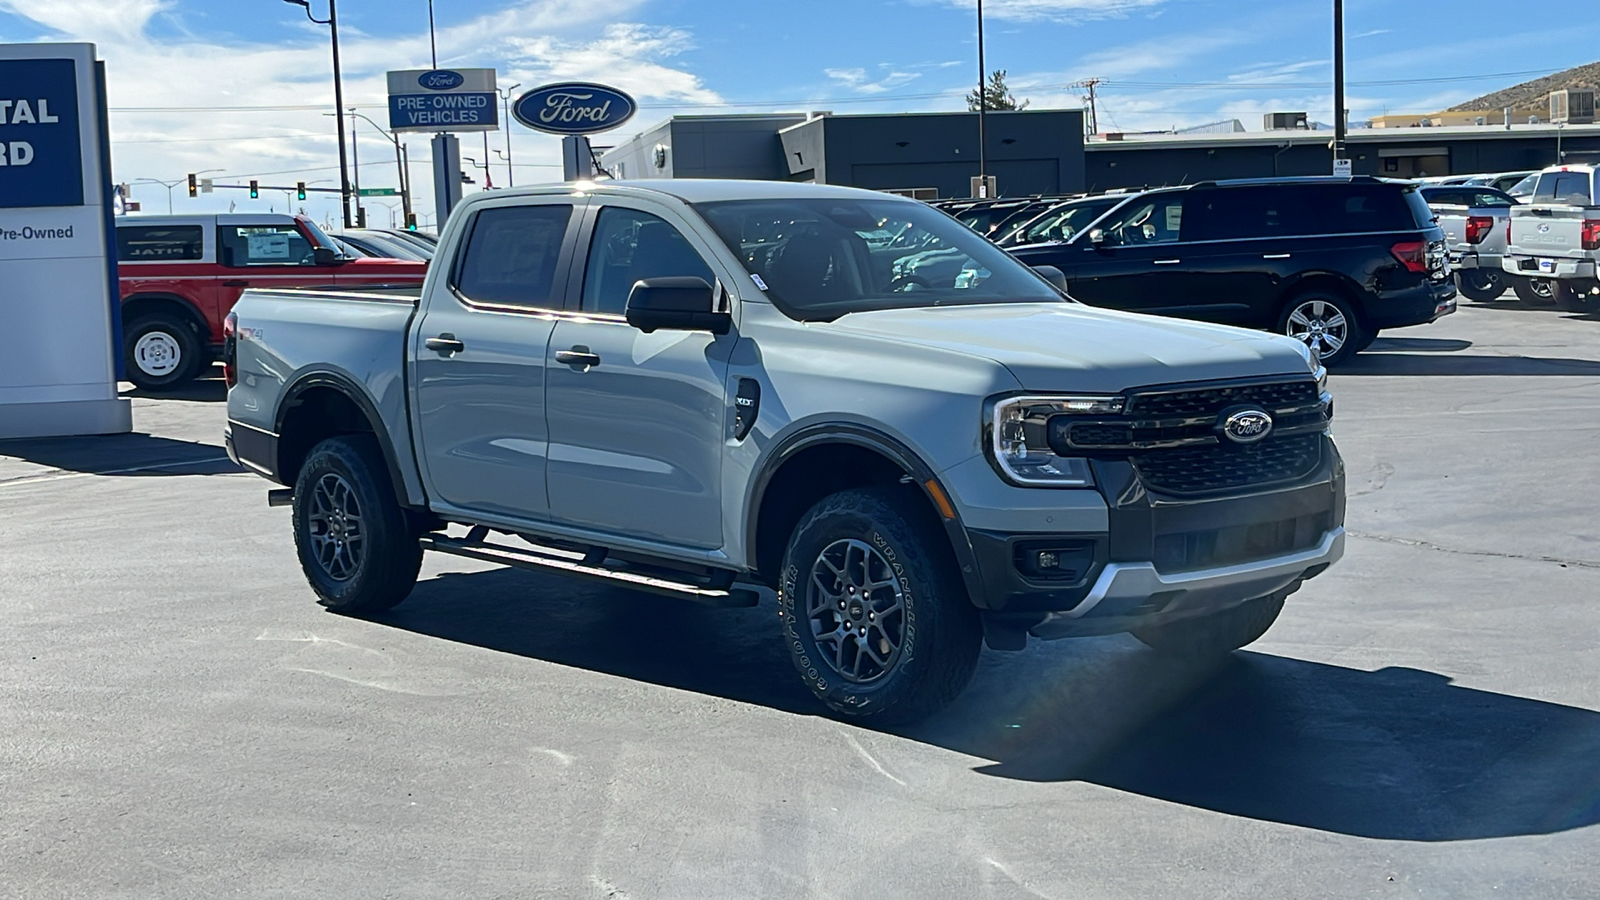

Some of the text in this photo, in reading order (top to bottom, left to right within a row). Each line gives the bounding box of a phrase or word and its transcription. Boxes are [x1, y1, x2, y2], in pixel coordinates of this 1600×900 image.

[428, 74, 454, 86] Ford
[540, 93, 611, 122] Ford
[408, 110, 478, 124] VEHICLES
[736, 397, 754, 407] XLT
[1237, 417, 1263, 435] Ford
[873, 531, 917, 655] WRANGLER
[786, 564, 829, 691] GOODYEAR
